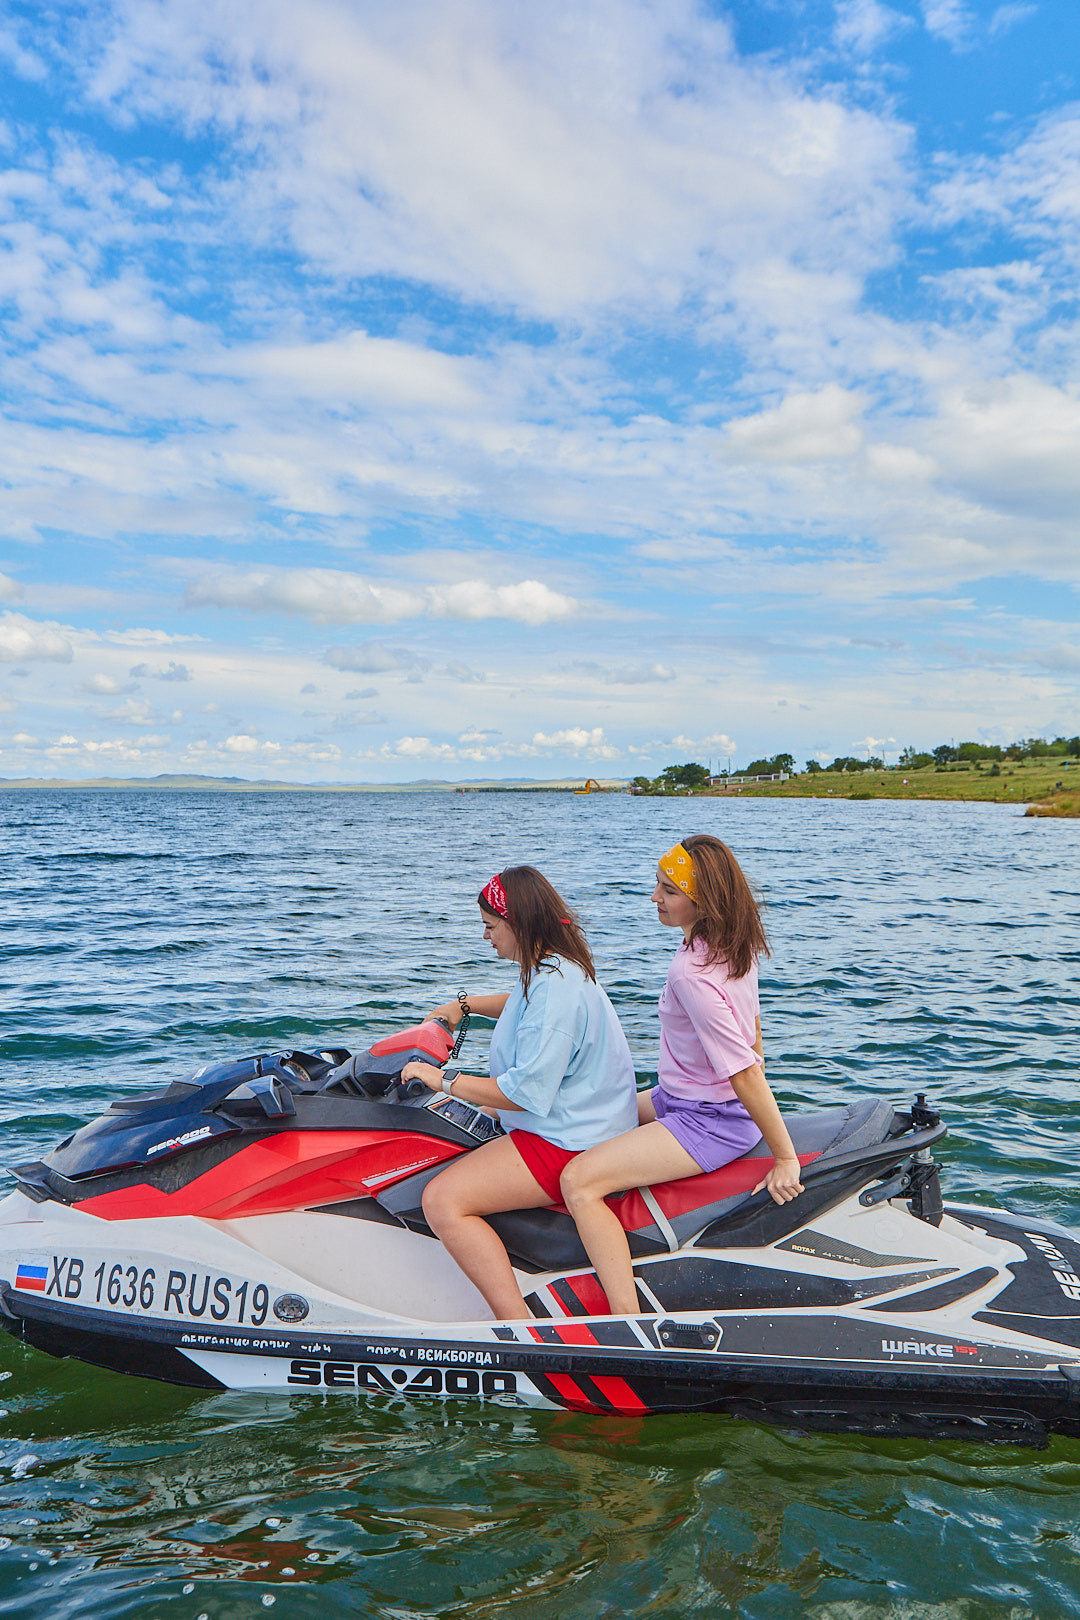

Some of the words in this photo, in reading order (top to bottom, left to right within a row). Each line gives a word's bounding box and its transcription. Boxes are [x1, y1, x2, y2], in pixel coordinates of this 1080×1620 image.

[791, 1244, 816, 1254] ROTAX
[94, 1261, 156, 1310] 1636
[163, 1270, 270, 1327] RUS19
[881, 1339, 954, 1358] WAKE
[954, 1345, 978, 1355] 155
